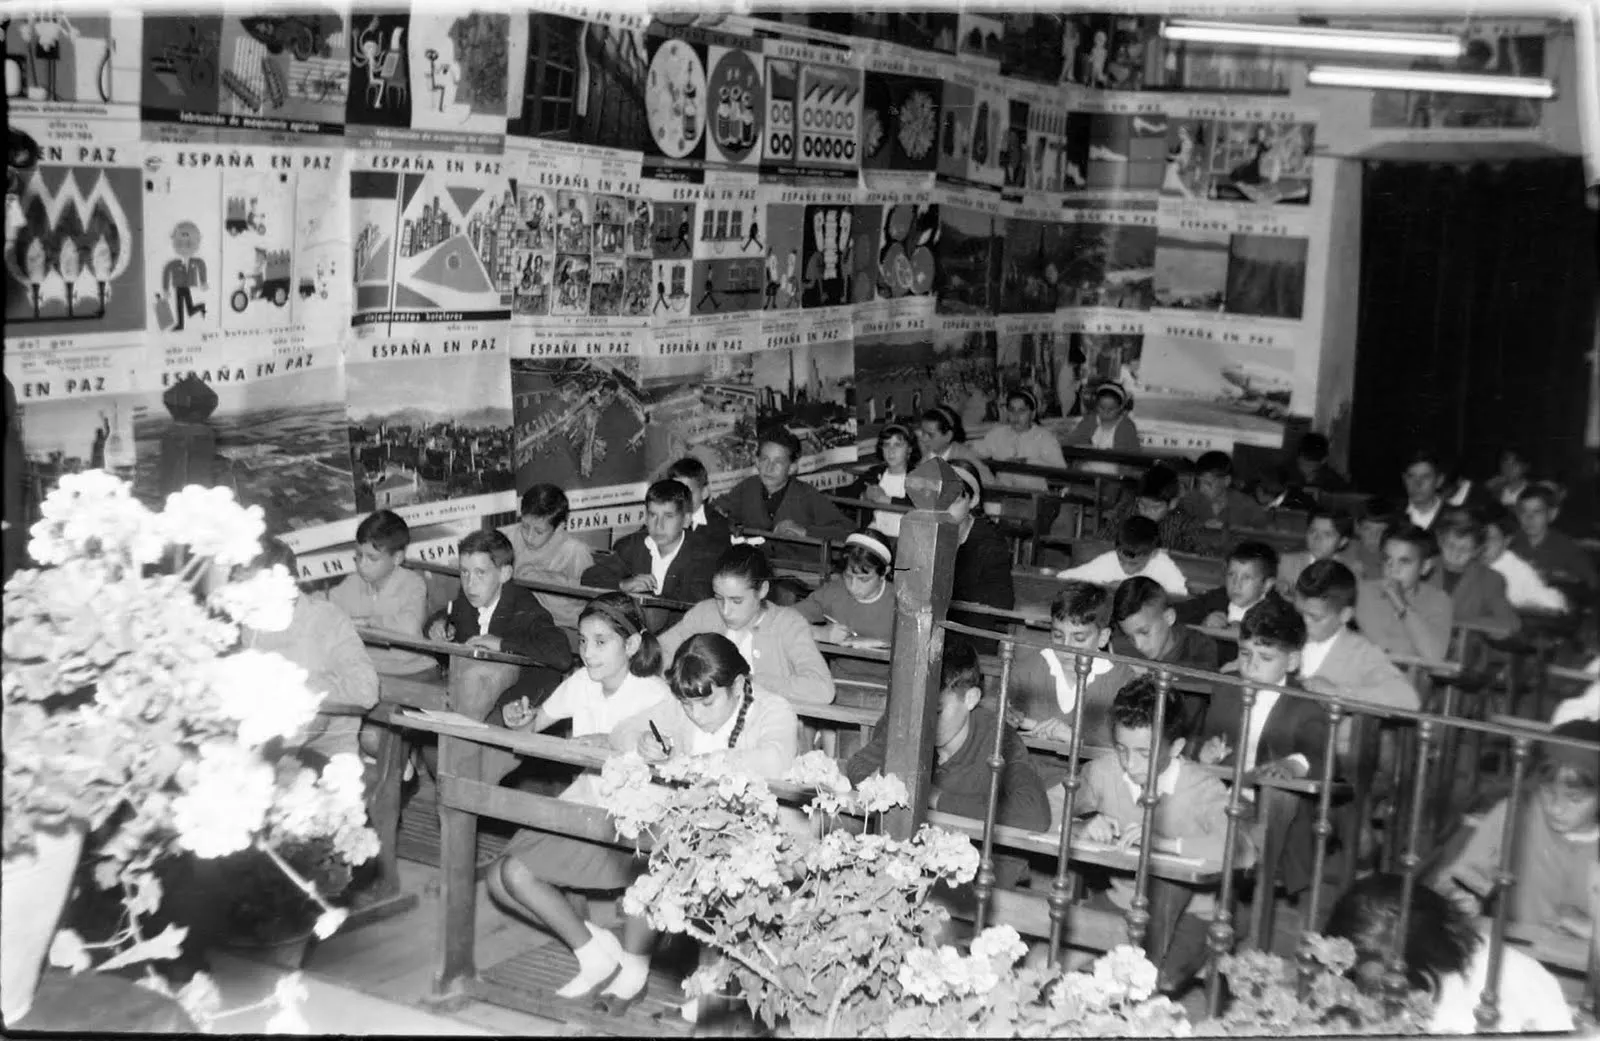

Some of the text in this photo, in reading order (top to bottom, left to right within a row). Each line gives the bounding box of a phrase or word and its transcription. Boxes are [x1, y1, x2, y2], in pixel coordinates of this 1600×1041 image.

[79, 146, 116, 162] PAZ
[177, 150, 331, 170] ESPAÑA EN PAZ
[372, 153, 501, 175] ESPAÑA EN PAZ
[540, 172, 640, 195] ESPAÑA EN PAZ
[673, 186, 715, 200] ESPAÑA
[739, 189, 756, 200] PAZ
[1180, 219, 1228, 231] ESPAÑA
[767, 333, 800, 348] ESPAÑA
[1167, 326, 1213, 340] ESPAÑA
[372, 337, 496, 358] ESPAÑA EN PAZ
[531, 340, 630, 355] ESPAÑA EN PAZ
[660, 340, 742, 354] ESPAÑA EN PAZ
[256, 363, 276, 377] EN
[285, 353, 313, 371] PAZ
[23, 377, 105, 397] EN PAZ
[569, 511, 608, 530] SPAÑA
[617, 512, 632, 525] EN
[420, 544, 455, 562] ESPA
[322, 557, 343, 574] EN
